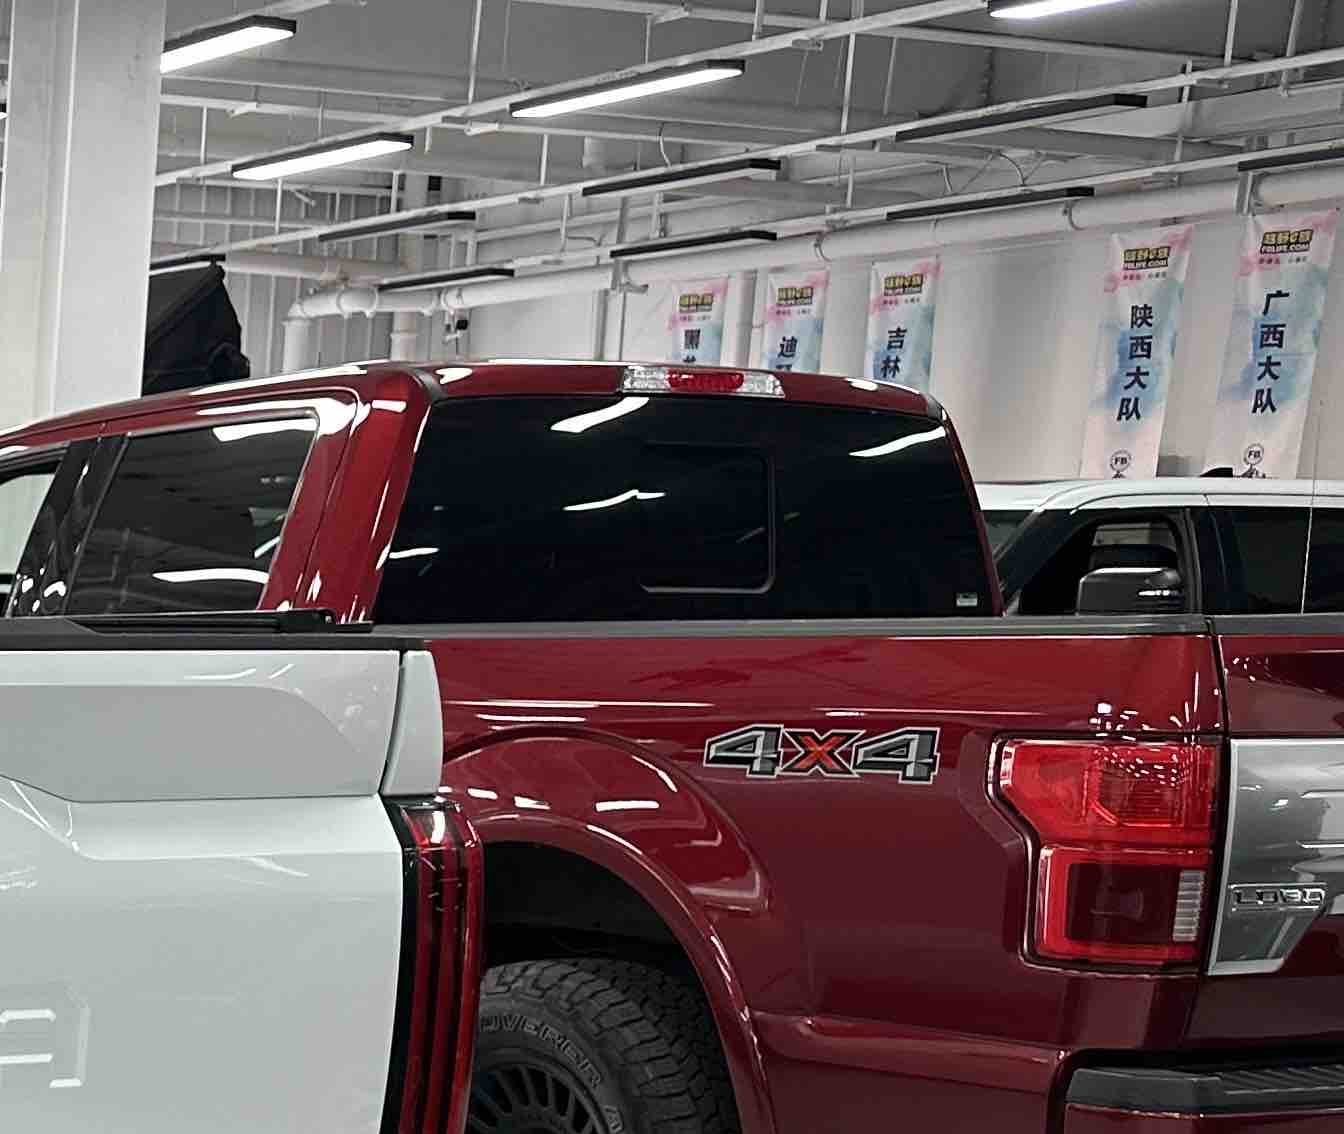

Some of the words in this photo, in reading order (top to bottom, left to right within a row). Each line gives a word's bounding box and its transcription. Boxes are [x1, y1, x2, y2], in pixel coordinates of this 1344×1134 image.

[1116, 304, 1154, 421] 陕西大队
[1252, 290, 1290, 413] 广西大队
